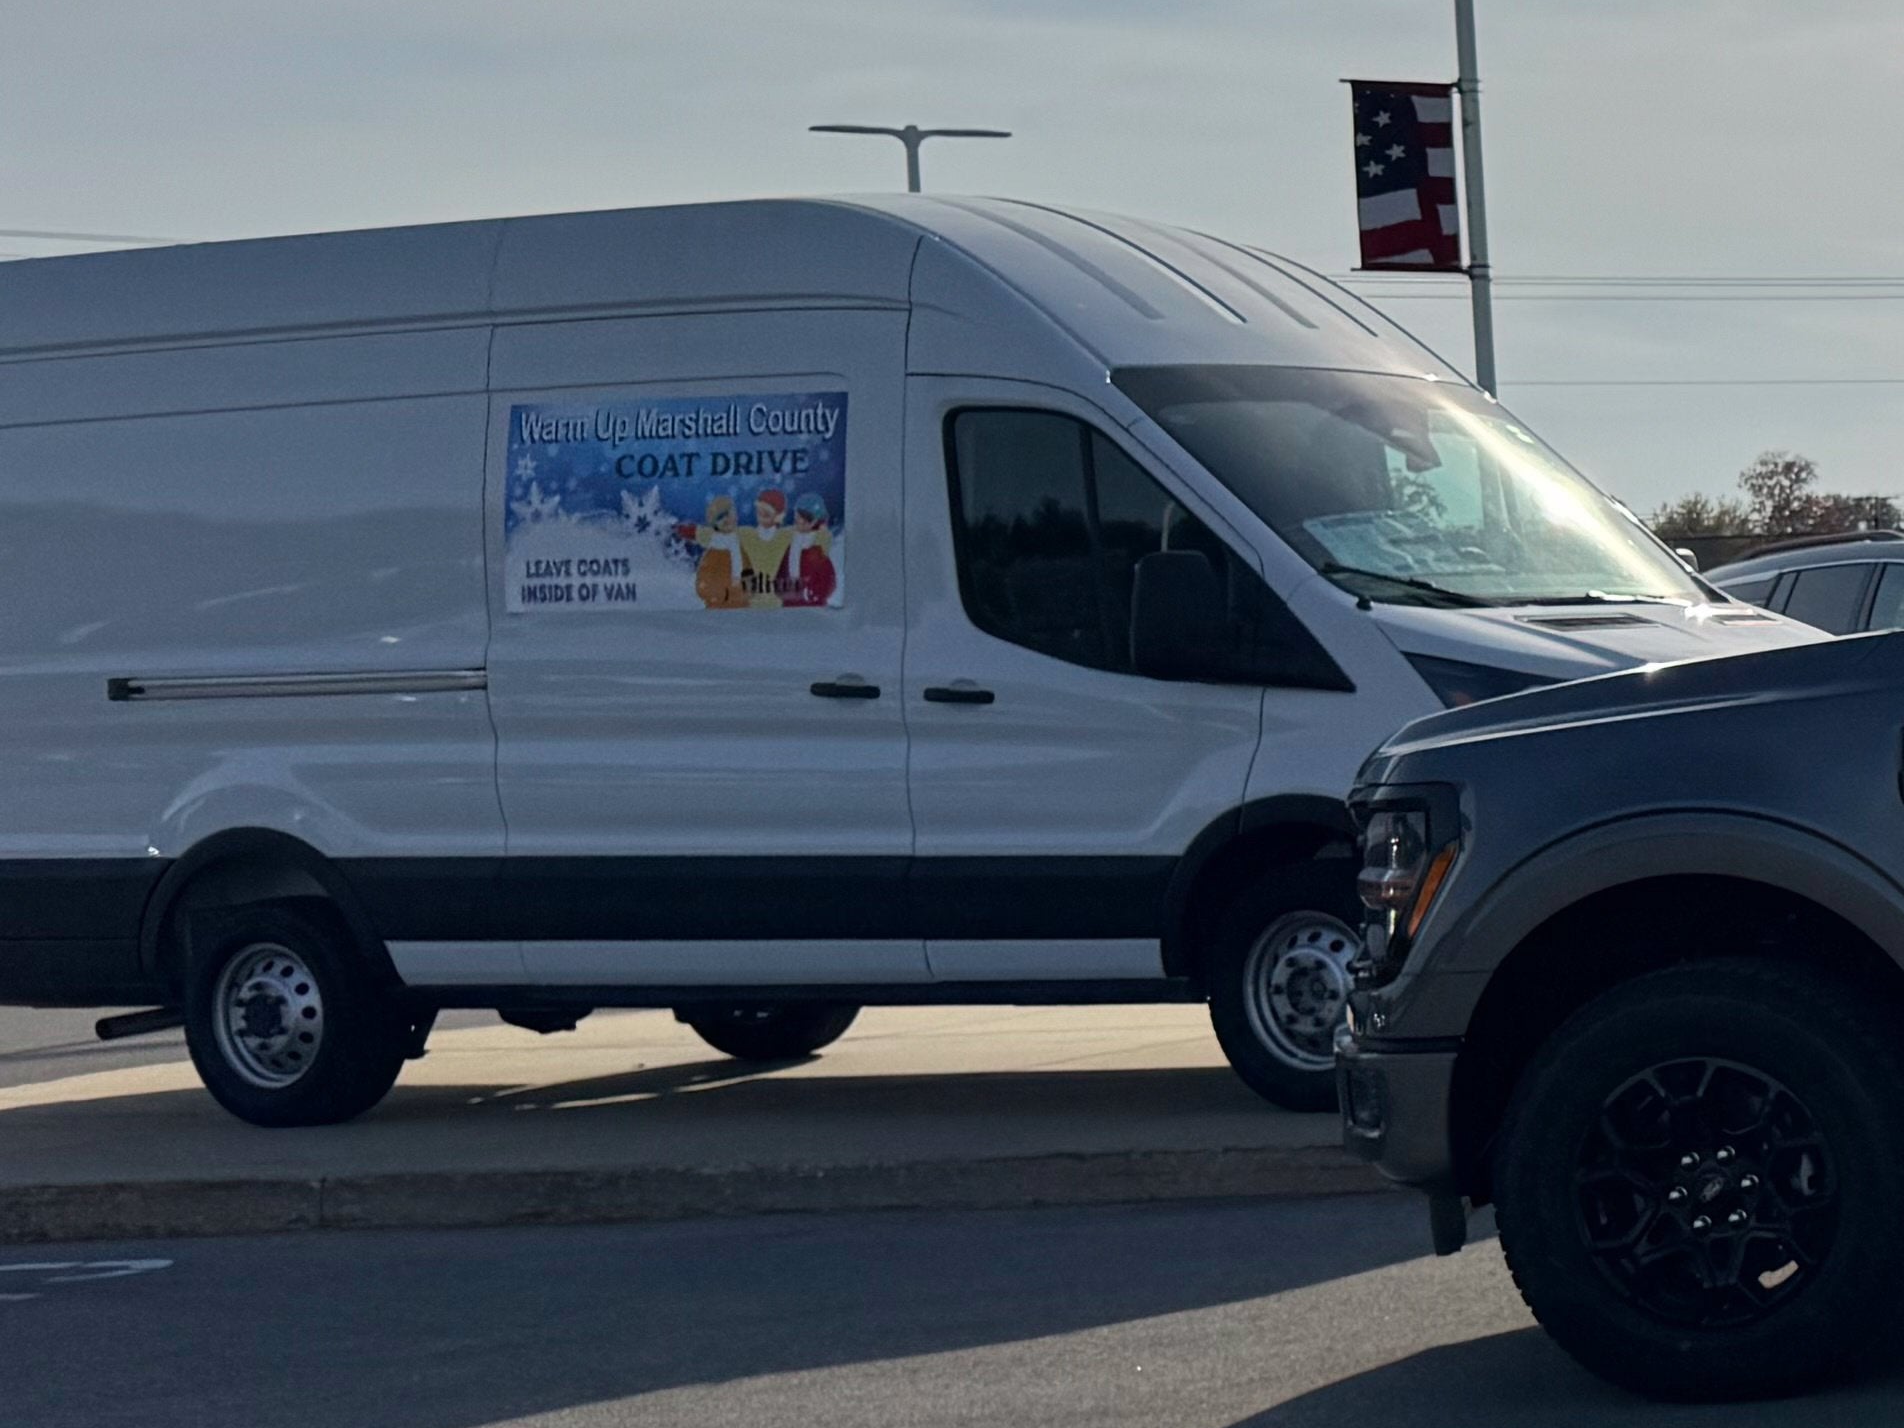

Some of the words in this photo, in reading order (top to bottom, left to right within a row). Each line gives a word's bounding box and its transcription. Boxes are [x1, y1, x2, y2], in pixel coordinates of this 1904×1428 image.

[521, 411, 588, 445] Warm
[595, 408, 628, 449] Up
[635, 401, 740, 440] Marshall
[749, 400, 839, 441] County
[615, 452, 700, 478] COAT
[710, 447, 809, 477] DRIVE
[526, 558, 573, 578] LEAVE
[577, 558, 630, 577] COATS
[521, 583, 573, 604] INSIDE
[578, 582, 599, 602] OF
[603, 582, 637, 602] VAN
